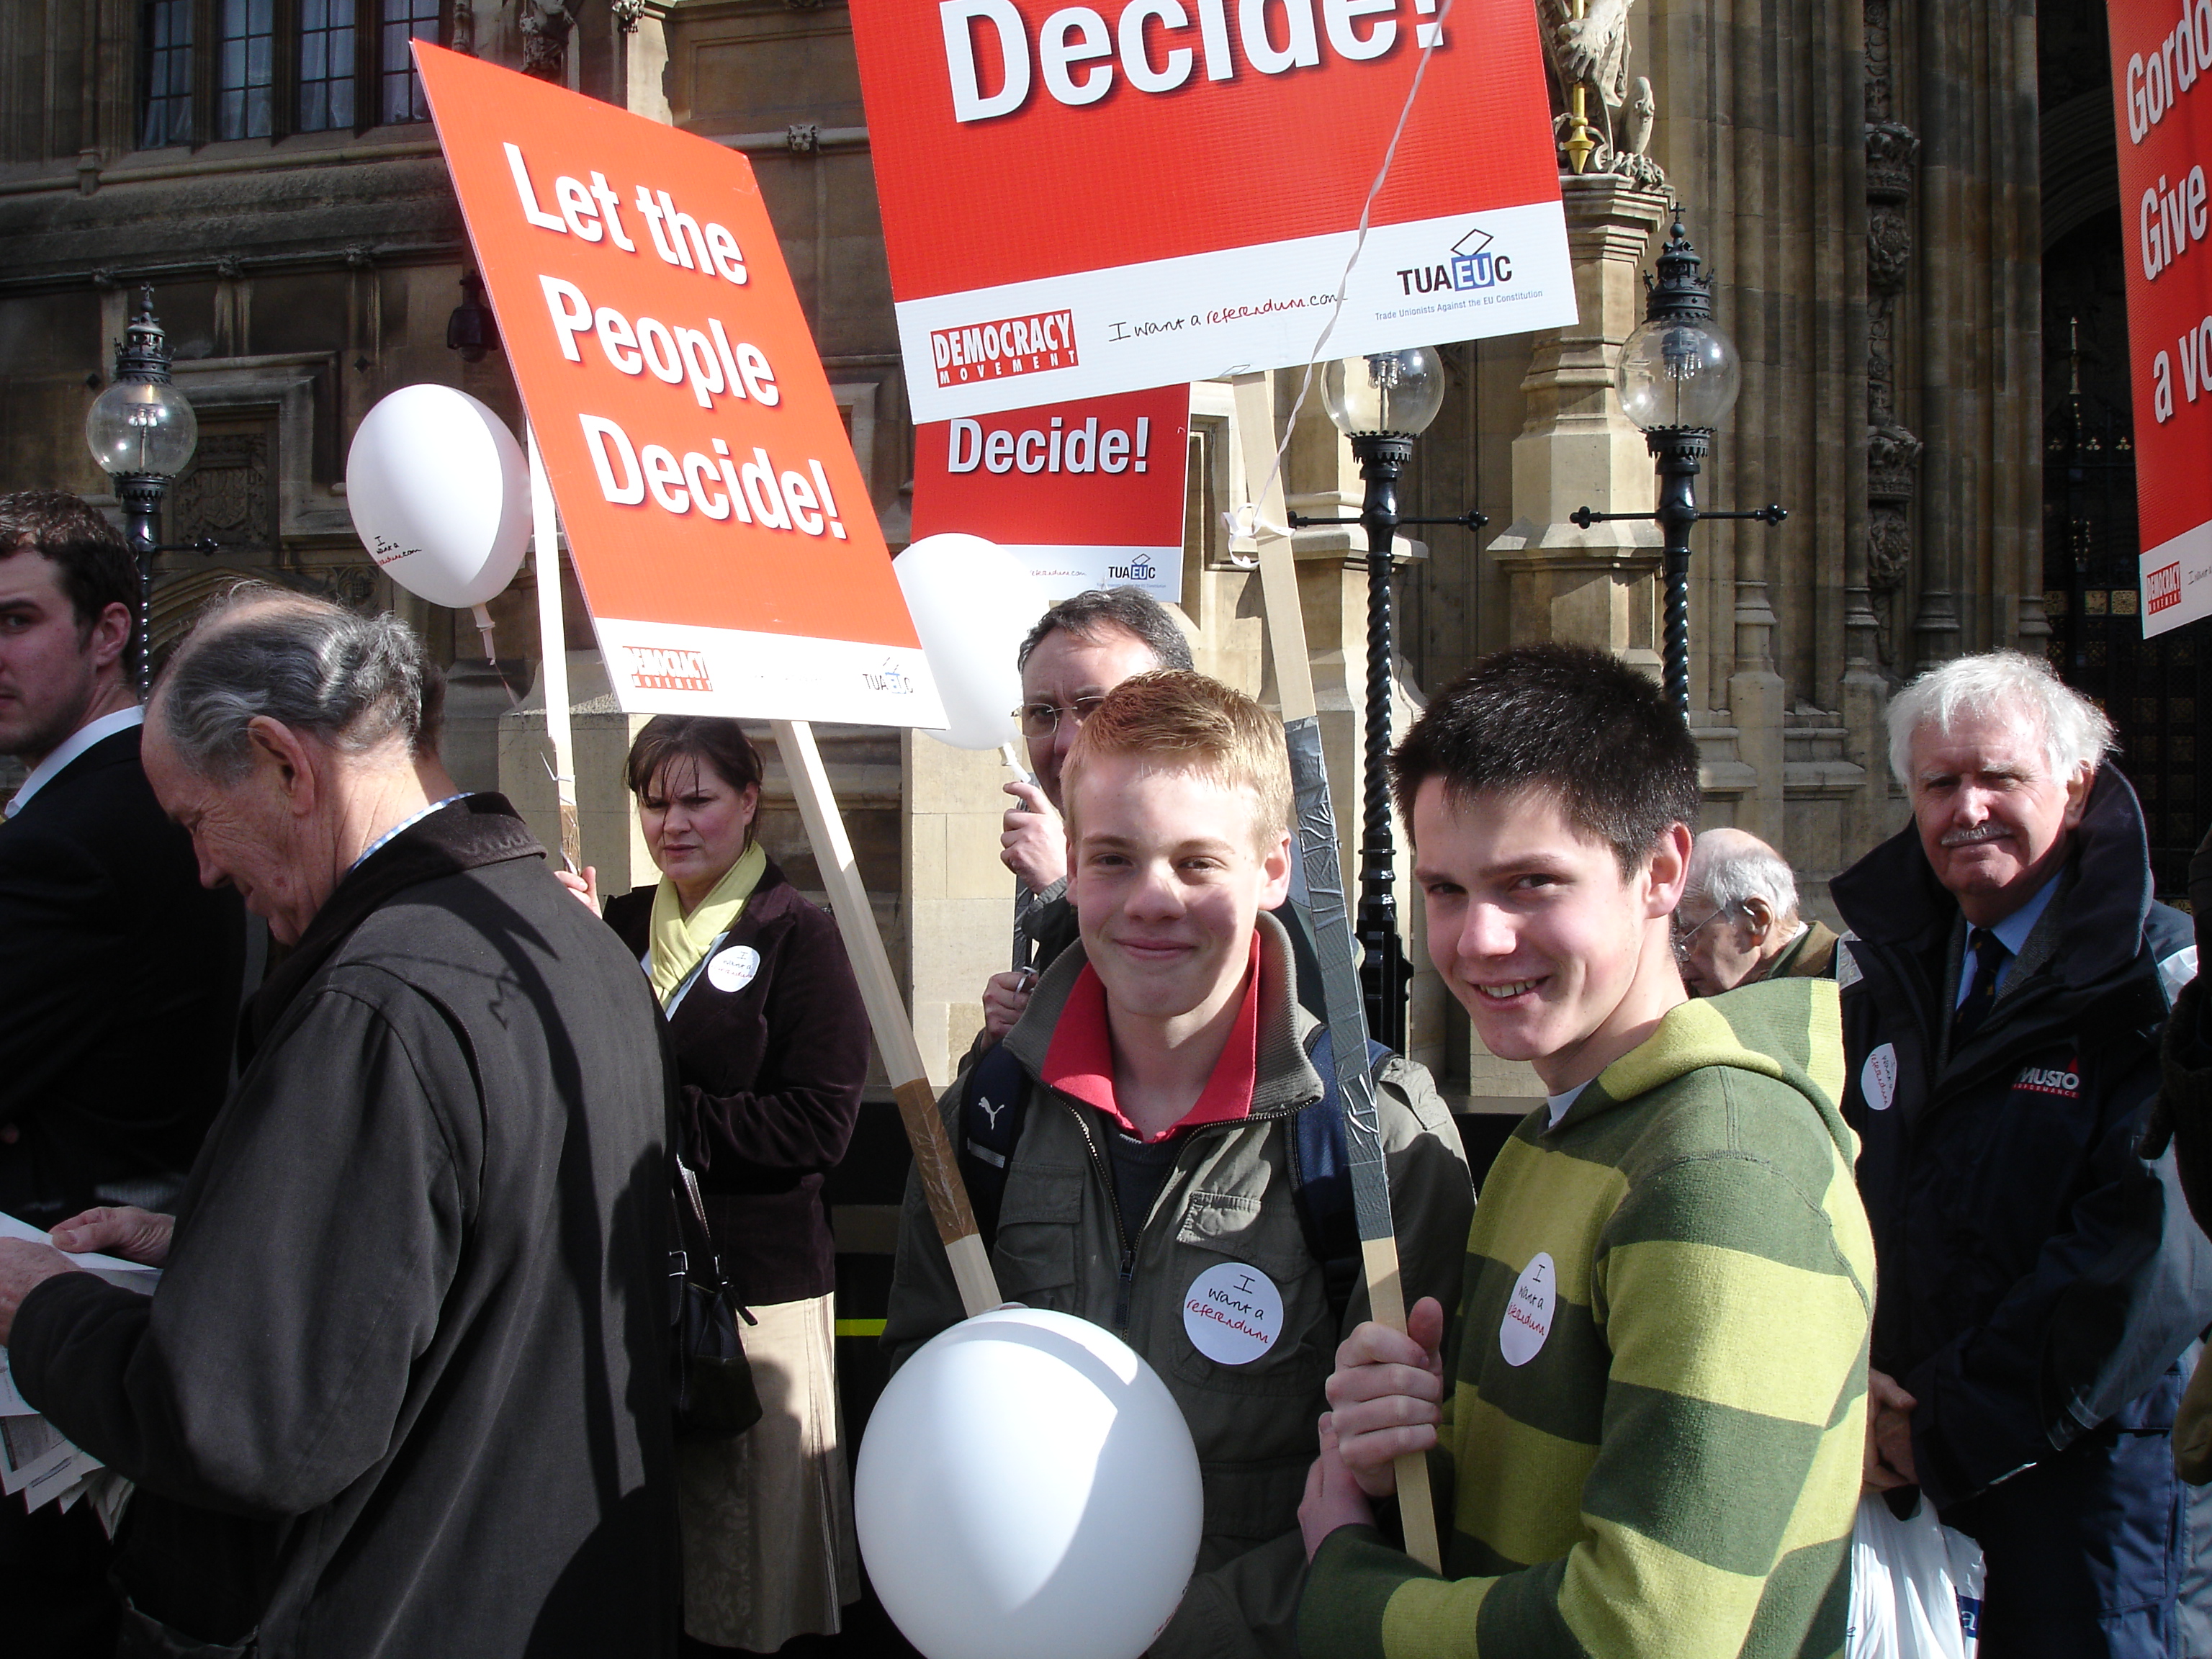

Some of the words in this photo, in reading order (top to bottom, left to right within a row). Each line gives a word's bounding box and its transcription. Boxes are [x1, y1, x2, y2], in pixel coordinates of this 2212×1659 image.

[503, 141, 636, 253] Let
[635, 184, 748, 285] the
[2141, 164, 2208, 282] Give
[1396, 255, 1513, 296] TUAEUC
[1375, 310, 1397, 321] Trade
[1399, 305, 1436, 318] Unionists
[1437, 300, 1467, 313] Against
[1467, 298, 1481, 307] the
[1483, 296, 1494, 305] EU
[1496, 289, 1544, 304] Constitution
[538, 274, 781, 410] People
[932, 312, 1071, 369] DEMOCRACY
[1108, 322, 1131, 342] I
[1134, 319, 1185, 338] want
[1190, 314, 1202, 326] a
[939, 350, 1076, 385] MOVEMENT
[2152, 349, 2174, 424] a
[947, 416, 1150, 475] Decide!
[577, 413, 848, 540] Decide!
[1107, 565, 1156, 580] TUAEUC
[2015, 1066, 2080, 1090] MUSTO
[1233, 1274, 1256, 1295] I
[1532, 1264, 1546, 1283] I
[1186, 1298, 1269, 1344] referendum
[1208, 1287, 1252, 1314] want
[1254, 1308, 1265, 1321] a
